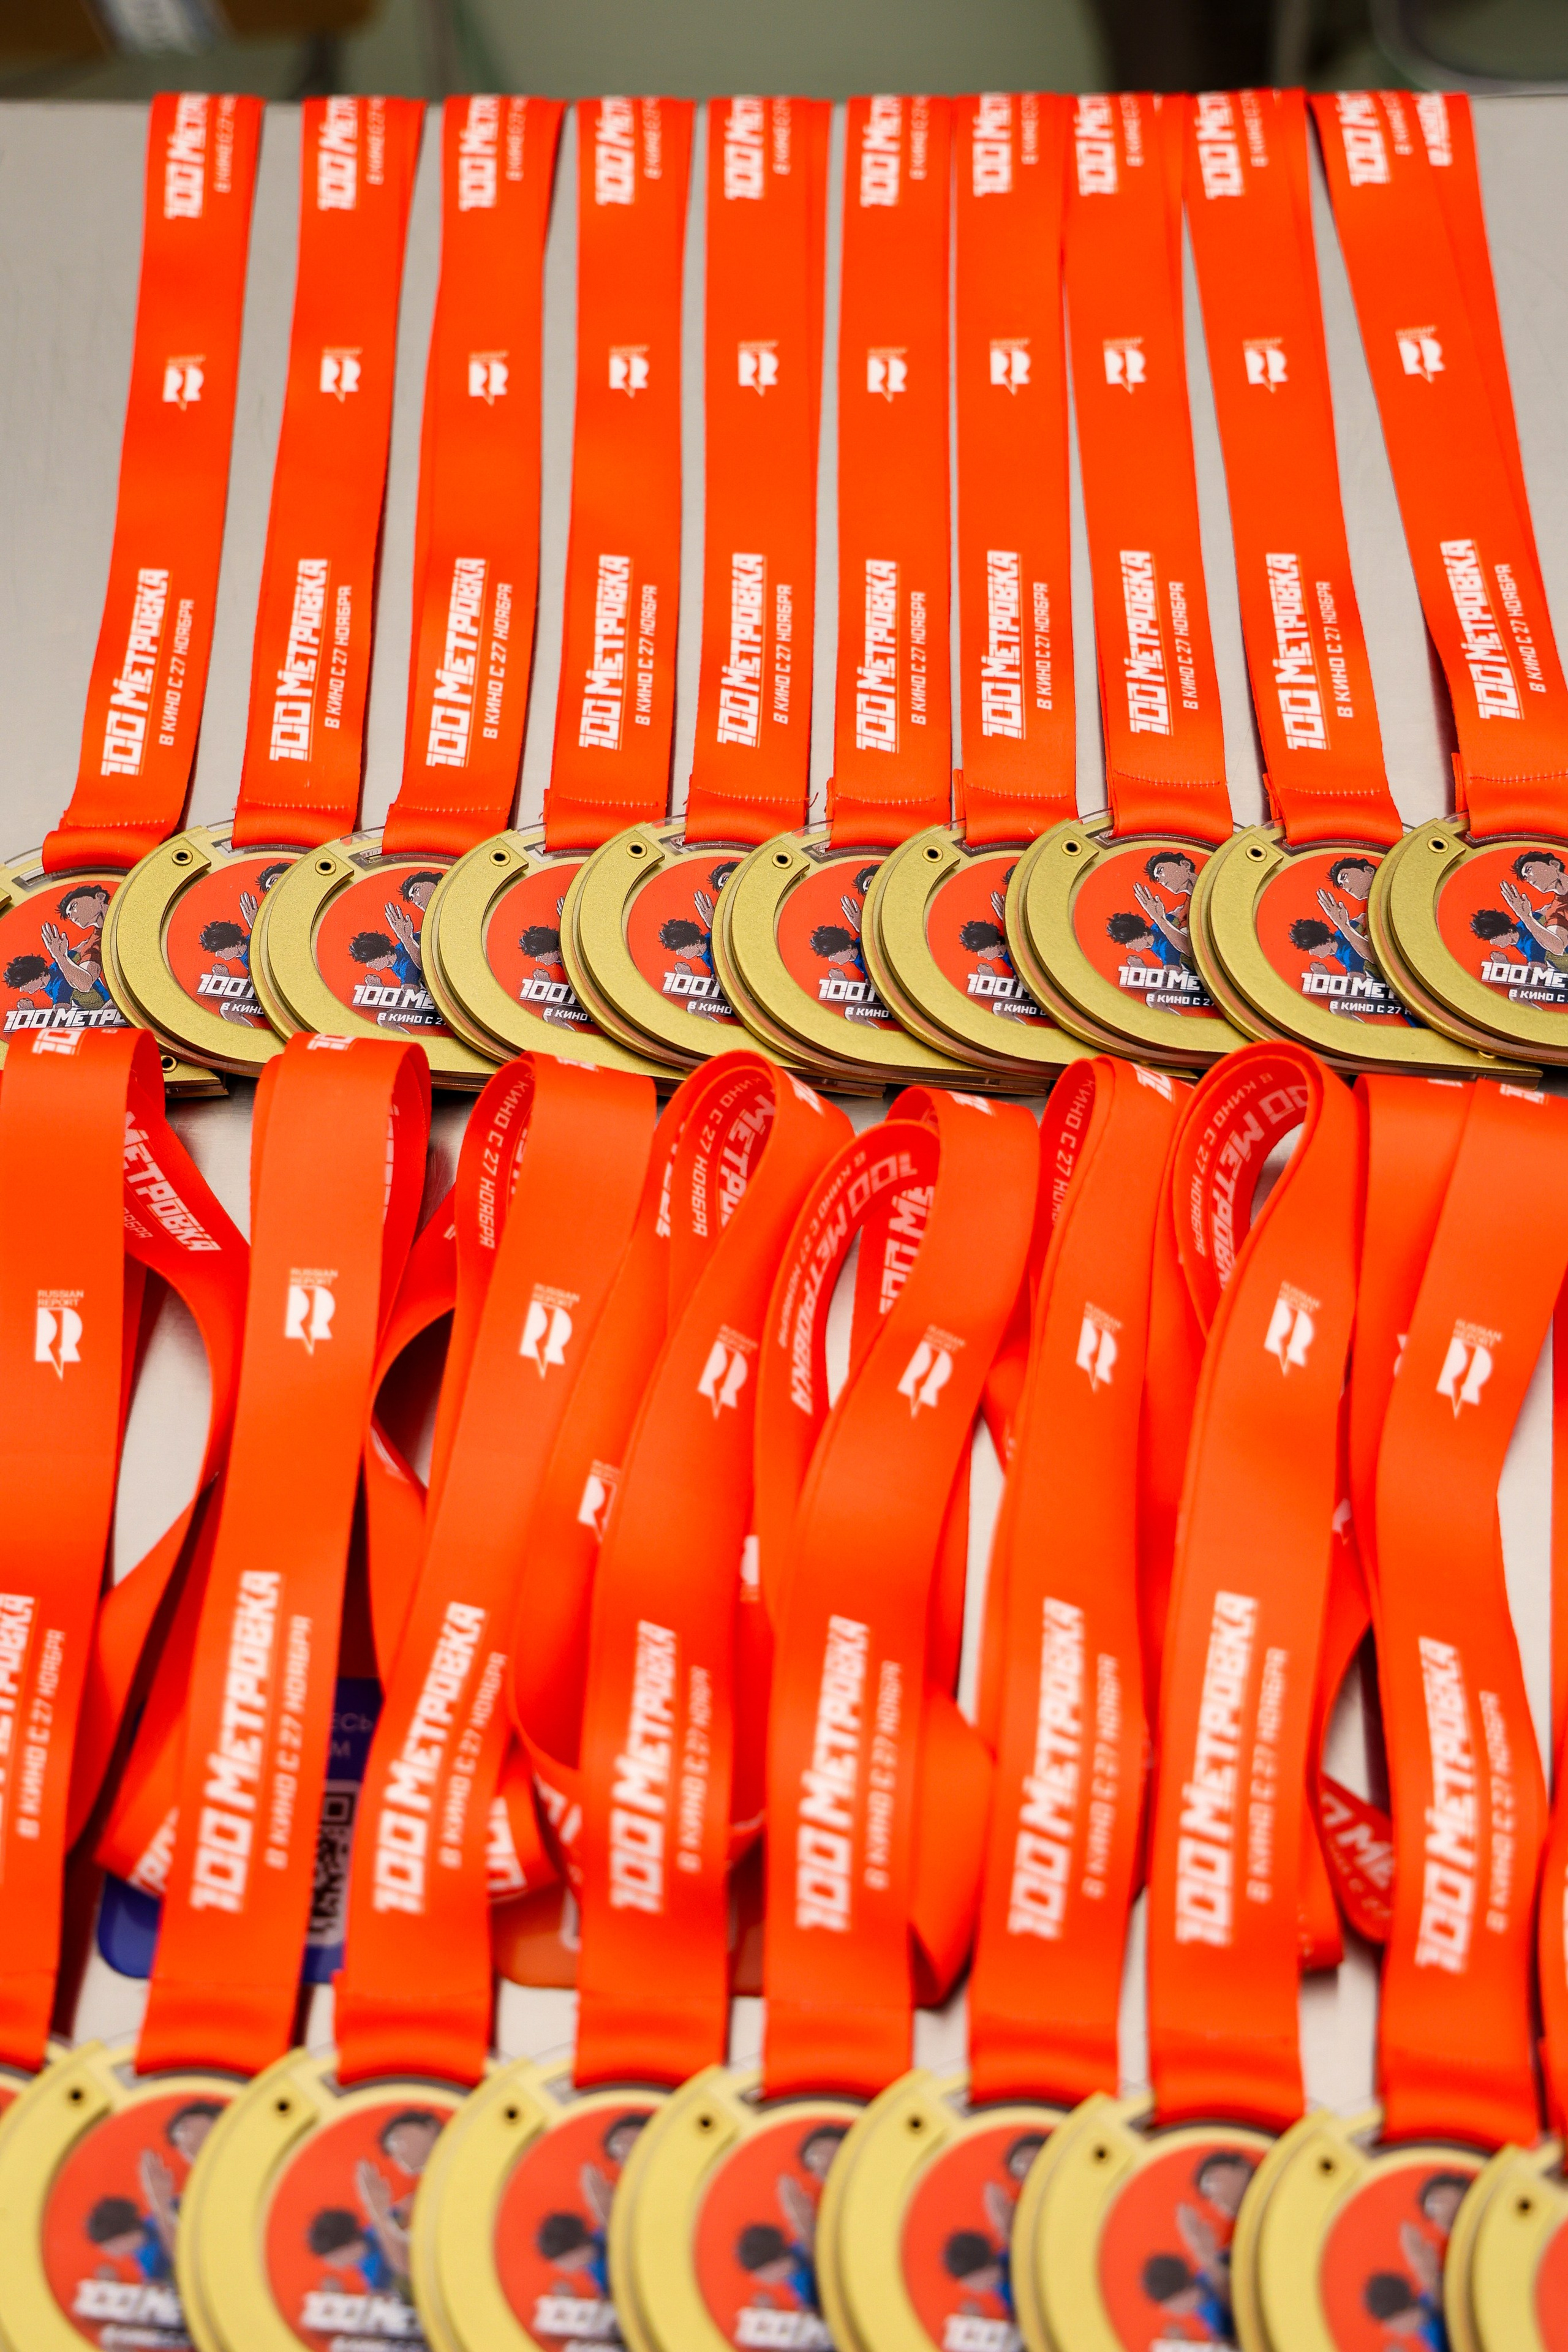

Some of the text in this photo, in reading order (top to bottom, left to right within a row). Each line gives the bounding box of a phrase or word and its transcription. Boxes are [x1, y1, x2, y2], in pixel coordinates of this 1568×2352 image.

[1494, 564, 1523, 617] НОЯБРЯ
[1033, 582, 1049, 633] НОЯБРЯ
[1510, 619, 1529, 633] 27
[635, 584, 657, 726] В КИНО С 27 НОЯБРЯ
[773, 584, 792, 724] В КИНО С 27 НОЯБРЯ
[1035, 634, 1050, 649] 27
[1169, 581, 1198, 710] В КИНО С 27 НОЯБРЯ
[1315, 581, 1354, 718] В КИНО С 27 НОЯБРЯ
[324, 586, 351, 729] В КИНО С 27 НОЯБРЯ
[482, 583, 511, 739] В КИНО С 27 НОЯБРЯ
[910, 591, 926, 725] В КИНО С 27 НОЯБРЯ
[1518, 646, 1542, 680] КИНО
[159, 599, 194, 746] В КИНО С 27 НОЯБРЯ
[1035, 660, 1051, 696] КИНО
[1529, 682, 1546, 693] В
[1036, 698, 1052, 710] В
[221, 1002, 230, 1012] В
[688, 1001, 732, 1014] В КИНО
[993, 1003, 1036, 1015] В КИНО
[1147, 993, 1155, 1002] В
[1158, 994, 1191, 1005] КИНО
[1193, 996, 1200, 1005] С
[1341, 1001, 1373, 1012] КИНО
[1376, 1005, 1384, 1014] С
[1387, 1005, 1401, 1014] 27
[1509, 989, 1565, 1001] В КИНО С
[377, 1012, 386, 1022] В
[388, 1013, 422, 1023] КИНО
[425, 1015, 432, 1024] С
[544, 1008, 587, 1020] В КИНО
[845, 1007, 889, 1018] В КИНО
[700, 1125, 716, 1153] 27
[1060, 1131, 1077, 1148] С
[479, 1080, 529, 1249] КИНО С 27 НОЯБРЯ
[1055, 1150, 1073, 1177] 27
[1196, 1144, 1208, 1175] 27
[692, 1155, 707, 1237] НОЯБРЯ
[1190, 1174, 1206, 1257] НОЯБРЯ
